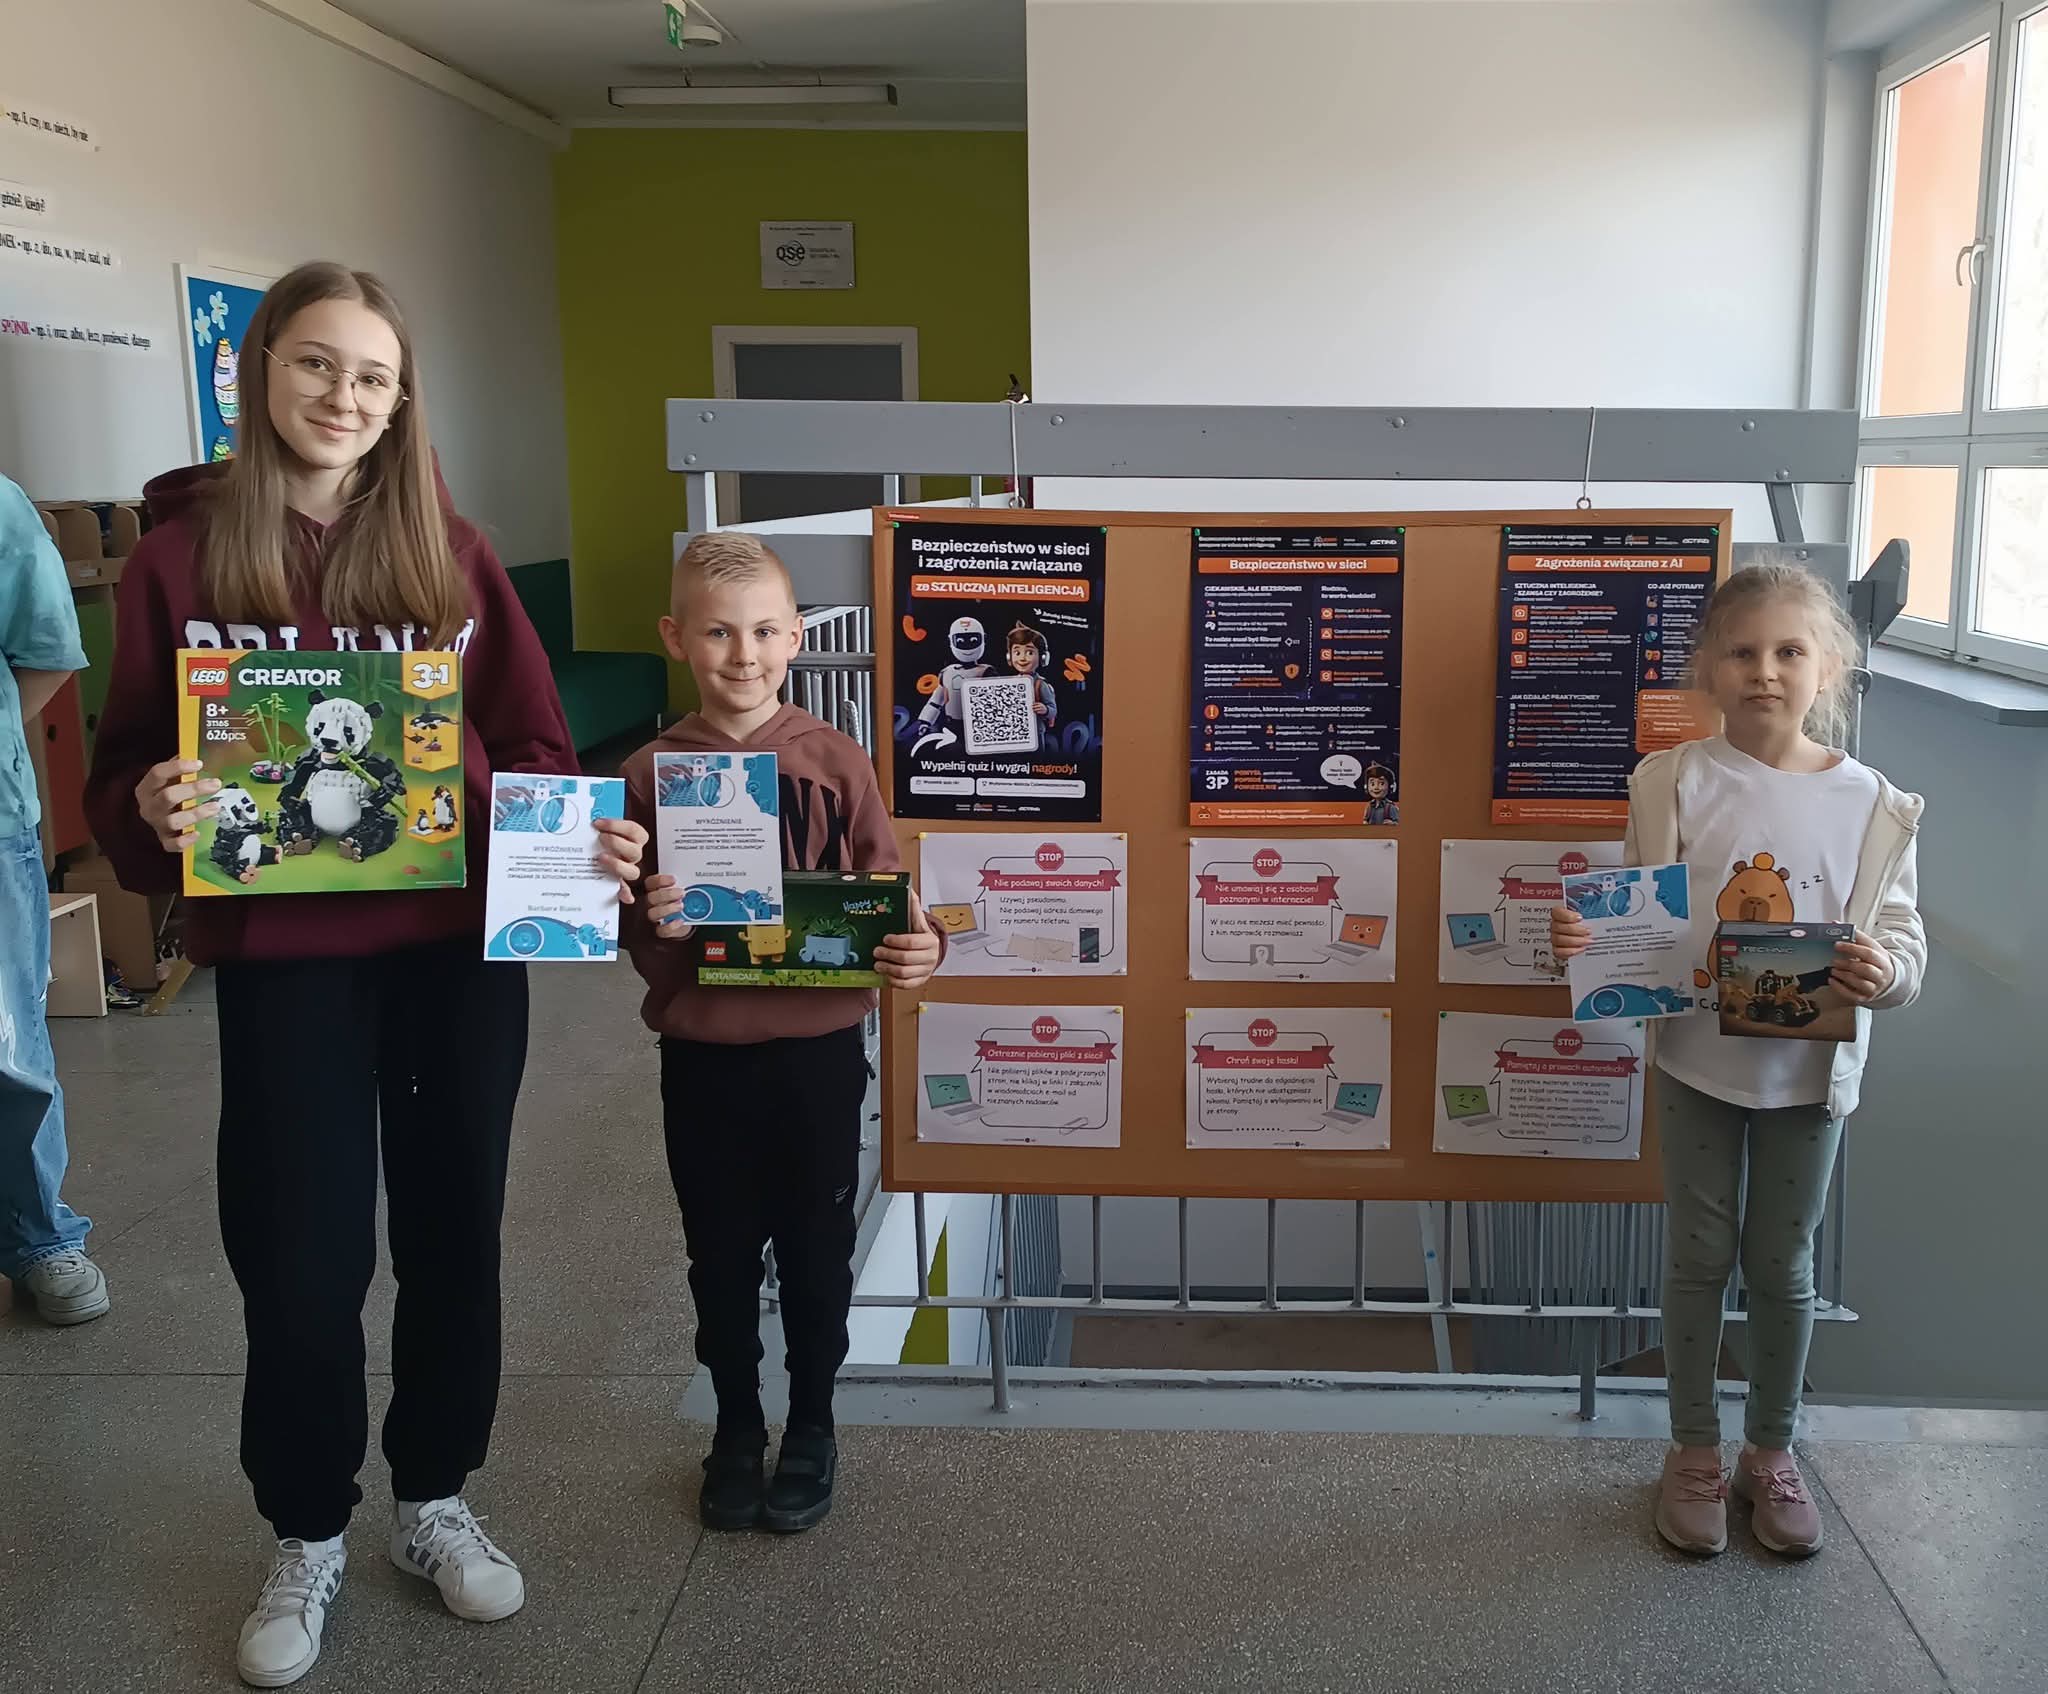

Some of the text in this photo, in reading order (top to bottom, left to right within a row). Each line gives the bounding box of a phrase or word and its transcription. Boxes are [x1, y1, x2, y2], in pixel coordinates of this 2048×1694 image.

[911, 538, 1090, 556] Bezpieczeństwo w sieci
[918, 555, 1083, 574] i zagrożenia związane
[1229, 559, 1367, 572] Bezpieczeństwo w sieci
[1535, 557, 1683, 571] Zagrożenia związane z AI
[916, 582, 1085, 598] ze SZTUCZNĄ INTELIGENCJĄ
[190, 668, 342, 686] LEGO CREATOR
[206, 703, 229, 717] 8+
[206, 730, 247, 743] 626pcs
[920, 760, 1078, 775] Wypełnij quiz i wygraj nagrody!
[1206, 776, 1229, 790] 3P
[1039, 853, 1062, 862] STOP
[1256, 859, 1279, 867] STOP
[1562, 862, 1586, 870] STOP
[1010, 880, 1044, 889] podawaj
[1074, 879, 1104, 889] danych!
[1231, 886, 1264, 894] umawiaj
[1265, 885, 1277, 893] się
[1286, 885, 1319, 893] osobami
[1519, 887, 1534, 895] Nie
[706, 947, 725, 955] LEGO
[1742, 945, 1793, 954] TECHNIC
[1035, 1026, 1058, 1034] STOP
[1252, 1028, 1275, 1037] STOP
[1557, 1038, 1580, 1047] STOP
[1226, 1056, 1250, 1064] Chroń
[1252, 1056, 1274, 1066] swoje
